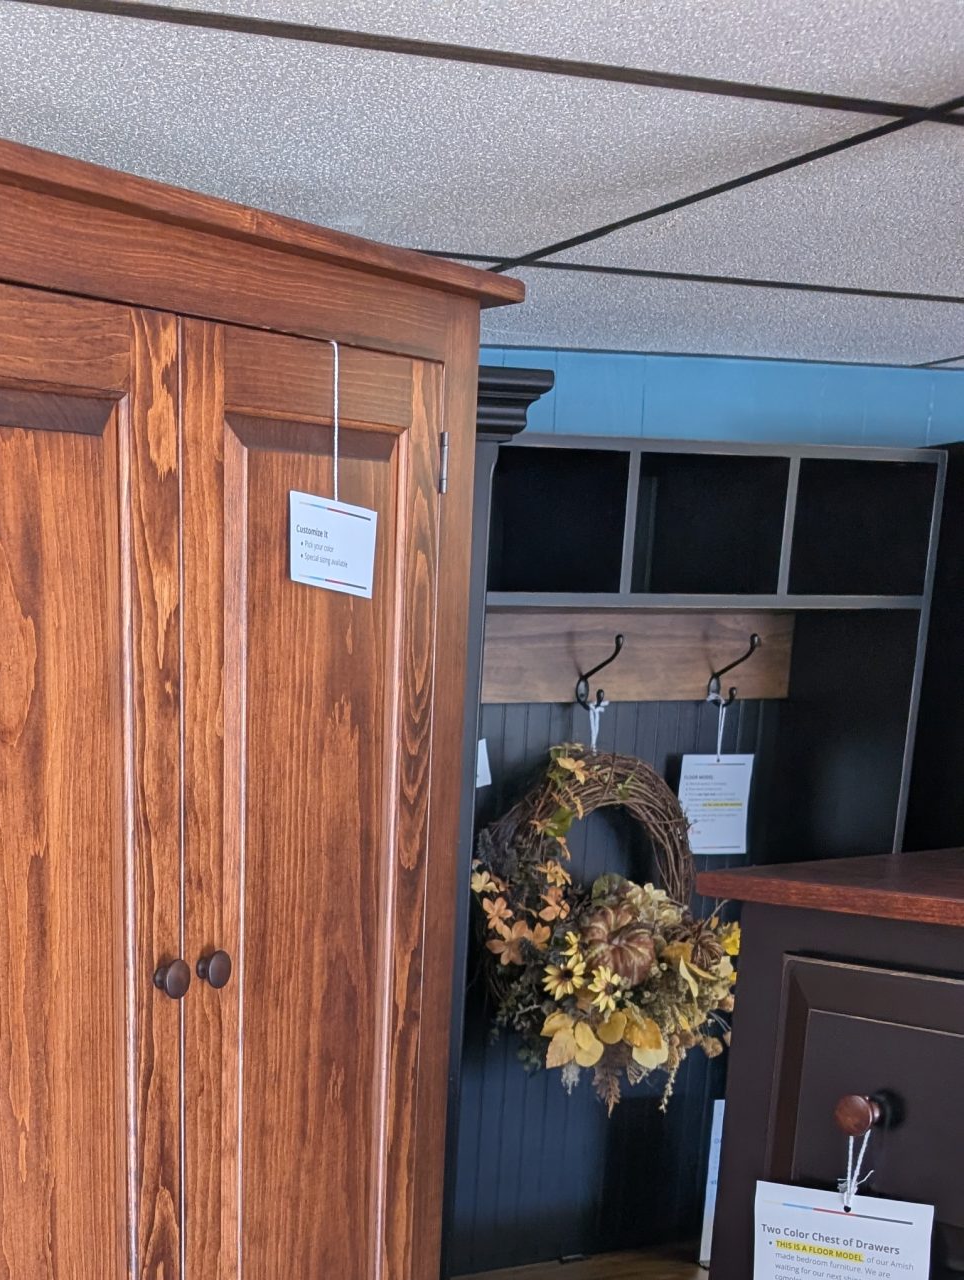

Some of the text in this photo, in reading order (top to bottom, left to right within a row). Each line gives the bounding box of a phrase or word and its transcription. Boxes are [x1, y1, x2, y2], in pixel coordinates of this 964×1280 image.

[296, 524, 323, 538] Customize
[304, 540, 313, 548] Pick
[314, 544, 323, 552] your
[304, 552, 348, 568] Special sizing available
[761, 1224, 900, 1254] Two Color Chest of Drawers
[775, 1252, 794, 1260] made
[796, 1255, 828, 1267] bedroom
[865, 1267, 876, 1275] We
[776, 1240, 792, 1249] THIS
[808, 1246, 833, 1256] FLOOR
[891, 1260, 914, 1271] Amish
[775, 1264, 800, 1274] waiting
